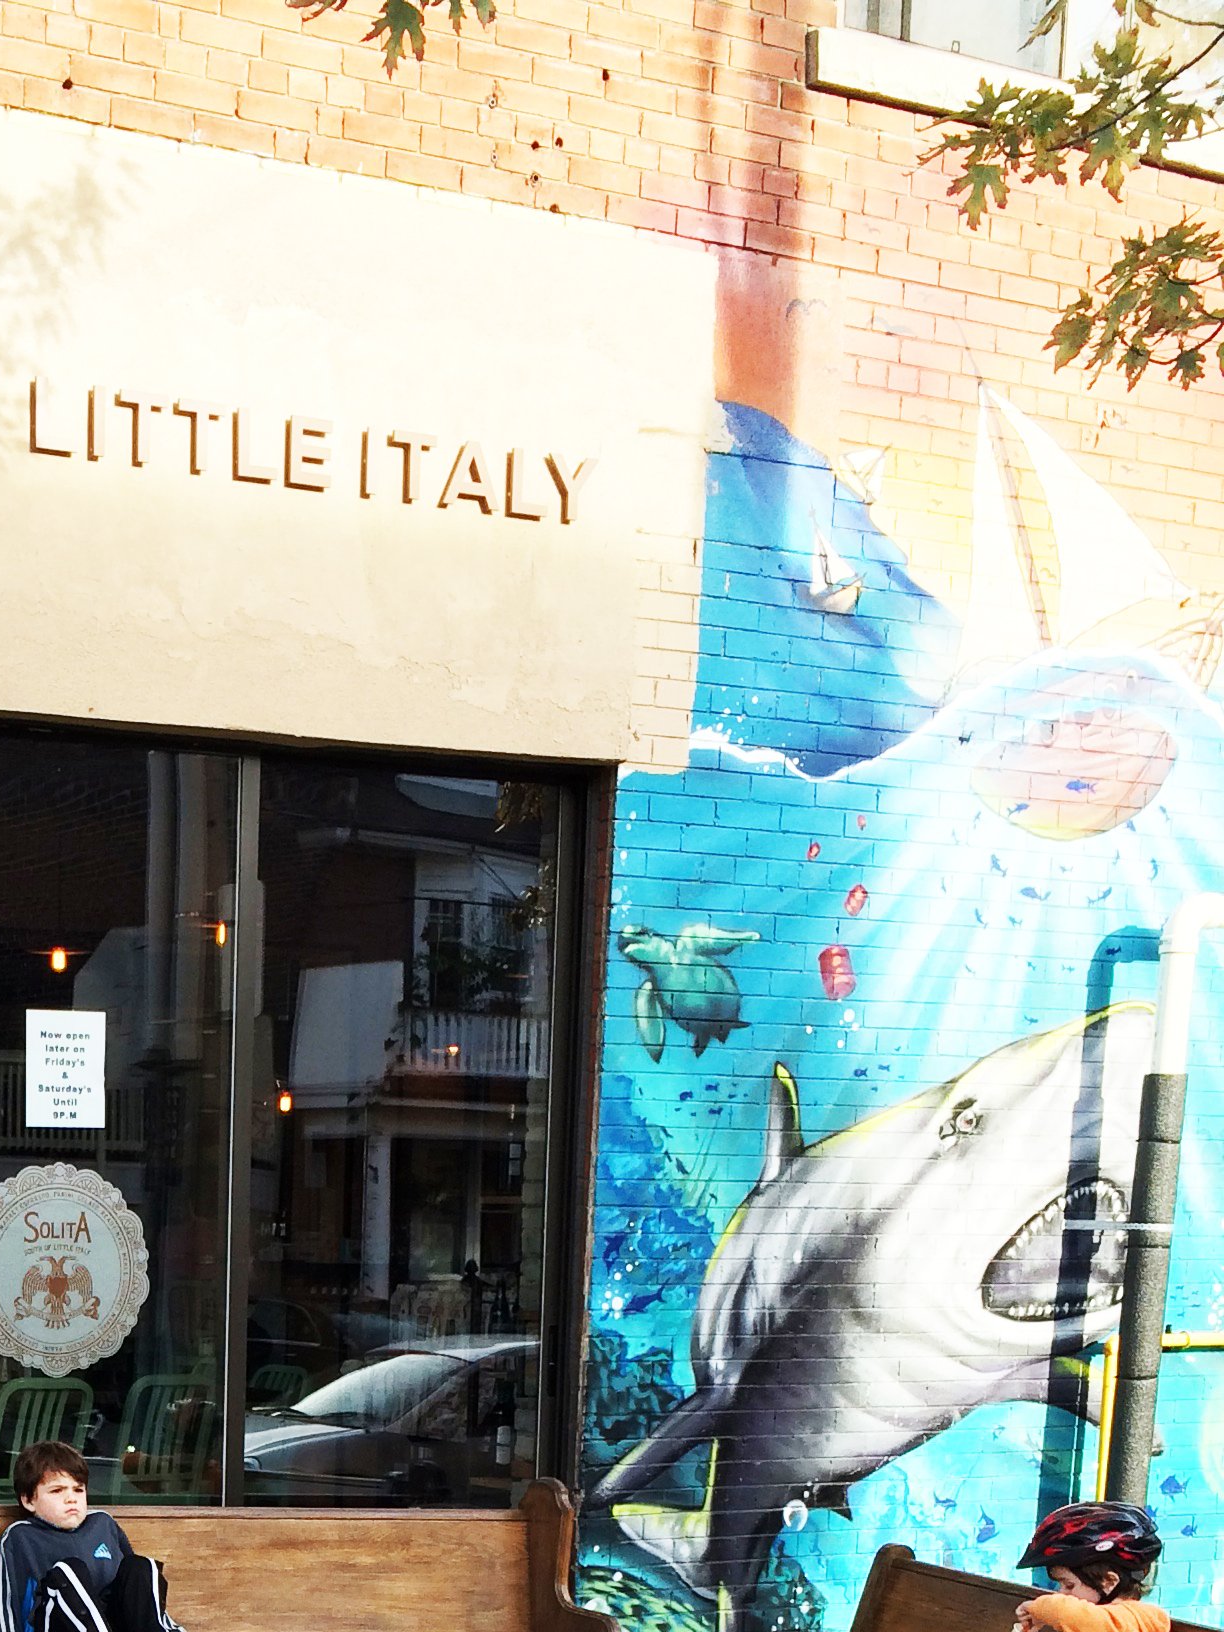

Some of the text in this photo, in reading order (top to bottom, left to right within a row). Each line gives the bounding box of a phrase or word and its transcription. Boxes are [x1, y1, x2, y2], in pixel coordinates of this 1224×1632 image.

[30, 376, 334, 492] LITTLE
[360, 426, 600, 525] ITALY
[40, 1030, 91, 1041] Now open
[45, 1044, 70, 1053] later
[45, 1058, 85, 1068] Friday's
[61, 1071, 69, 1079] &
[38, 1084, 92, 1095] Saturday's
[53, 1097, 78, 1107] Until
[23, 1211, 91, 1243] SOLITA
